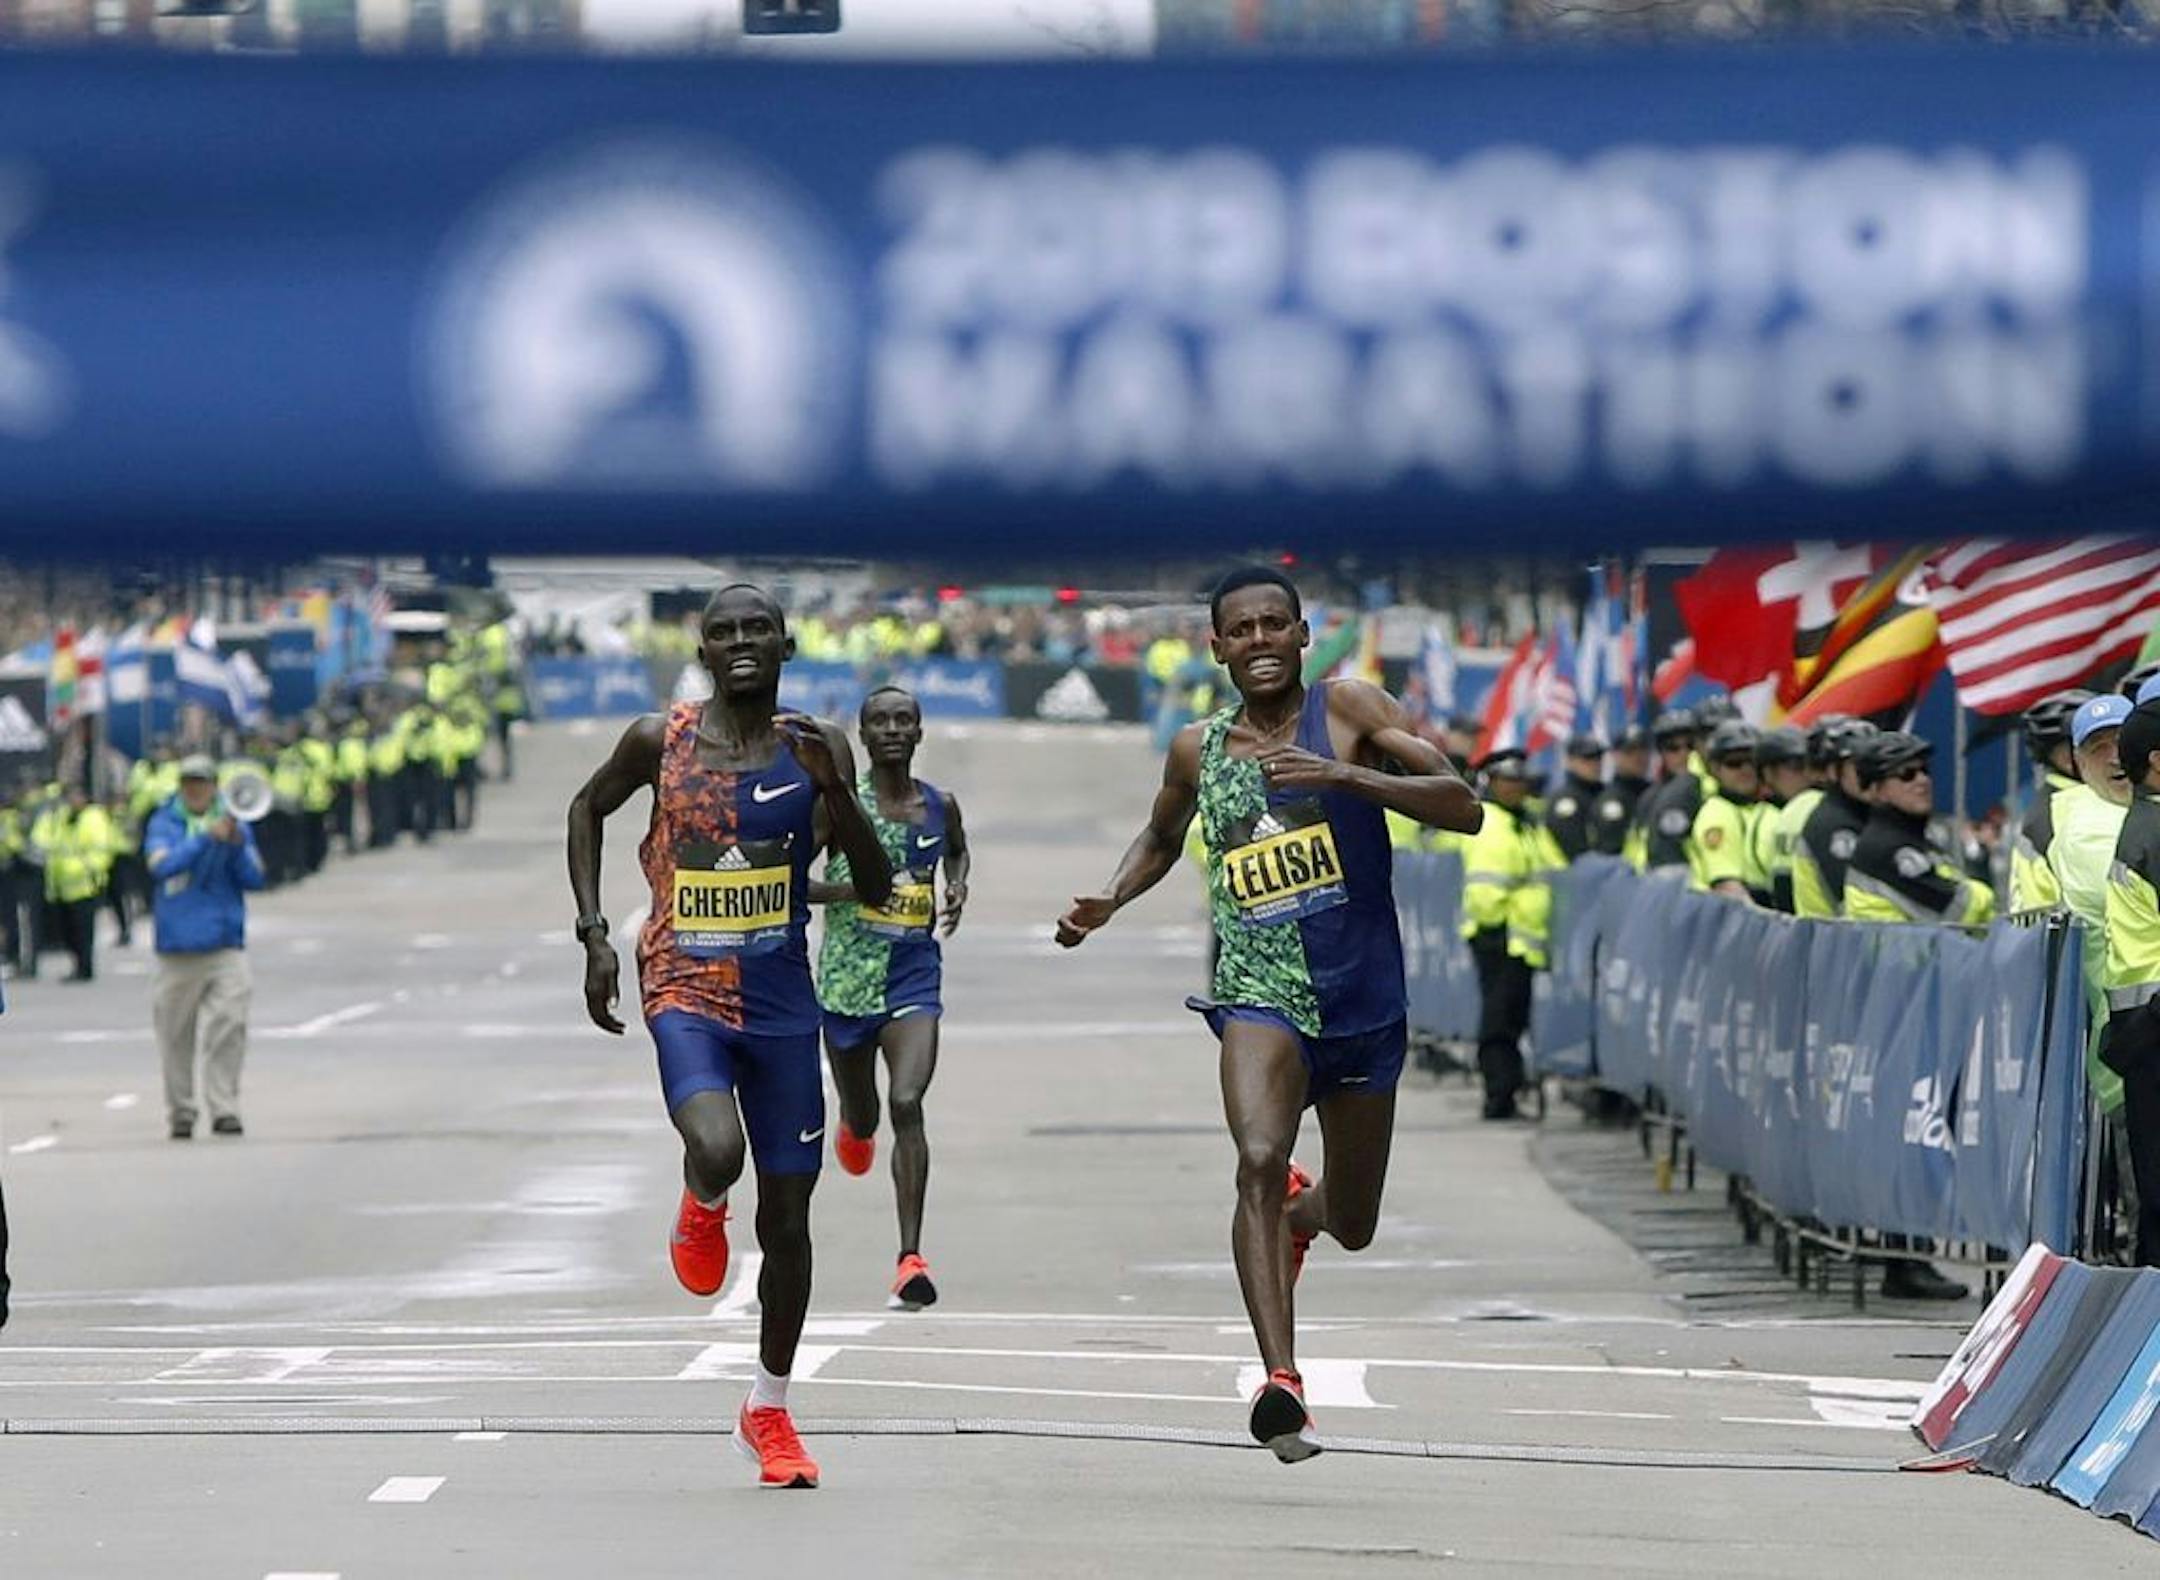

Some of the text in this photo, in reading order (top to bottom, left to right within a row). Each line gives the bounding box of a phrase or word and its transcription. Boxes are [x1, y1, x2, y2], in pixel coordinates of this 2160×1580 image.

[1299, 144, 2084, 326] BOSTON
[870, 318, 2084, 488] MARATHON
[679, 882, 786, 917] CHERONO
[1227, 836, 1335, 900] LELISA
